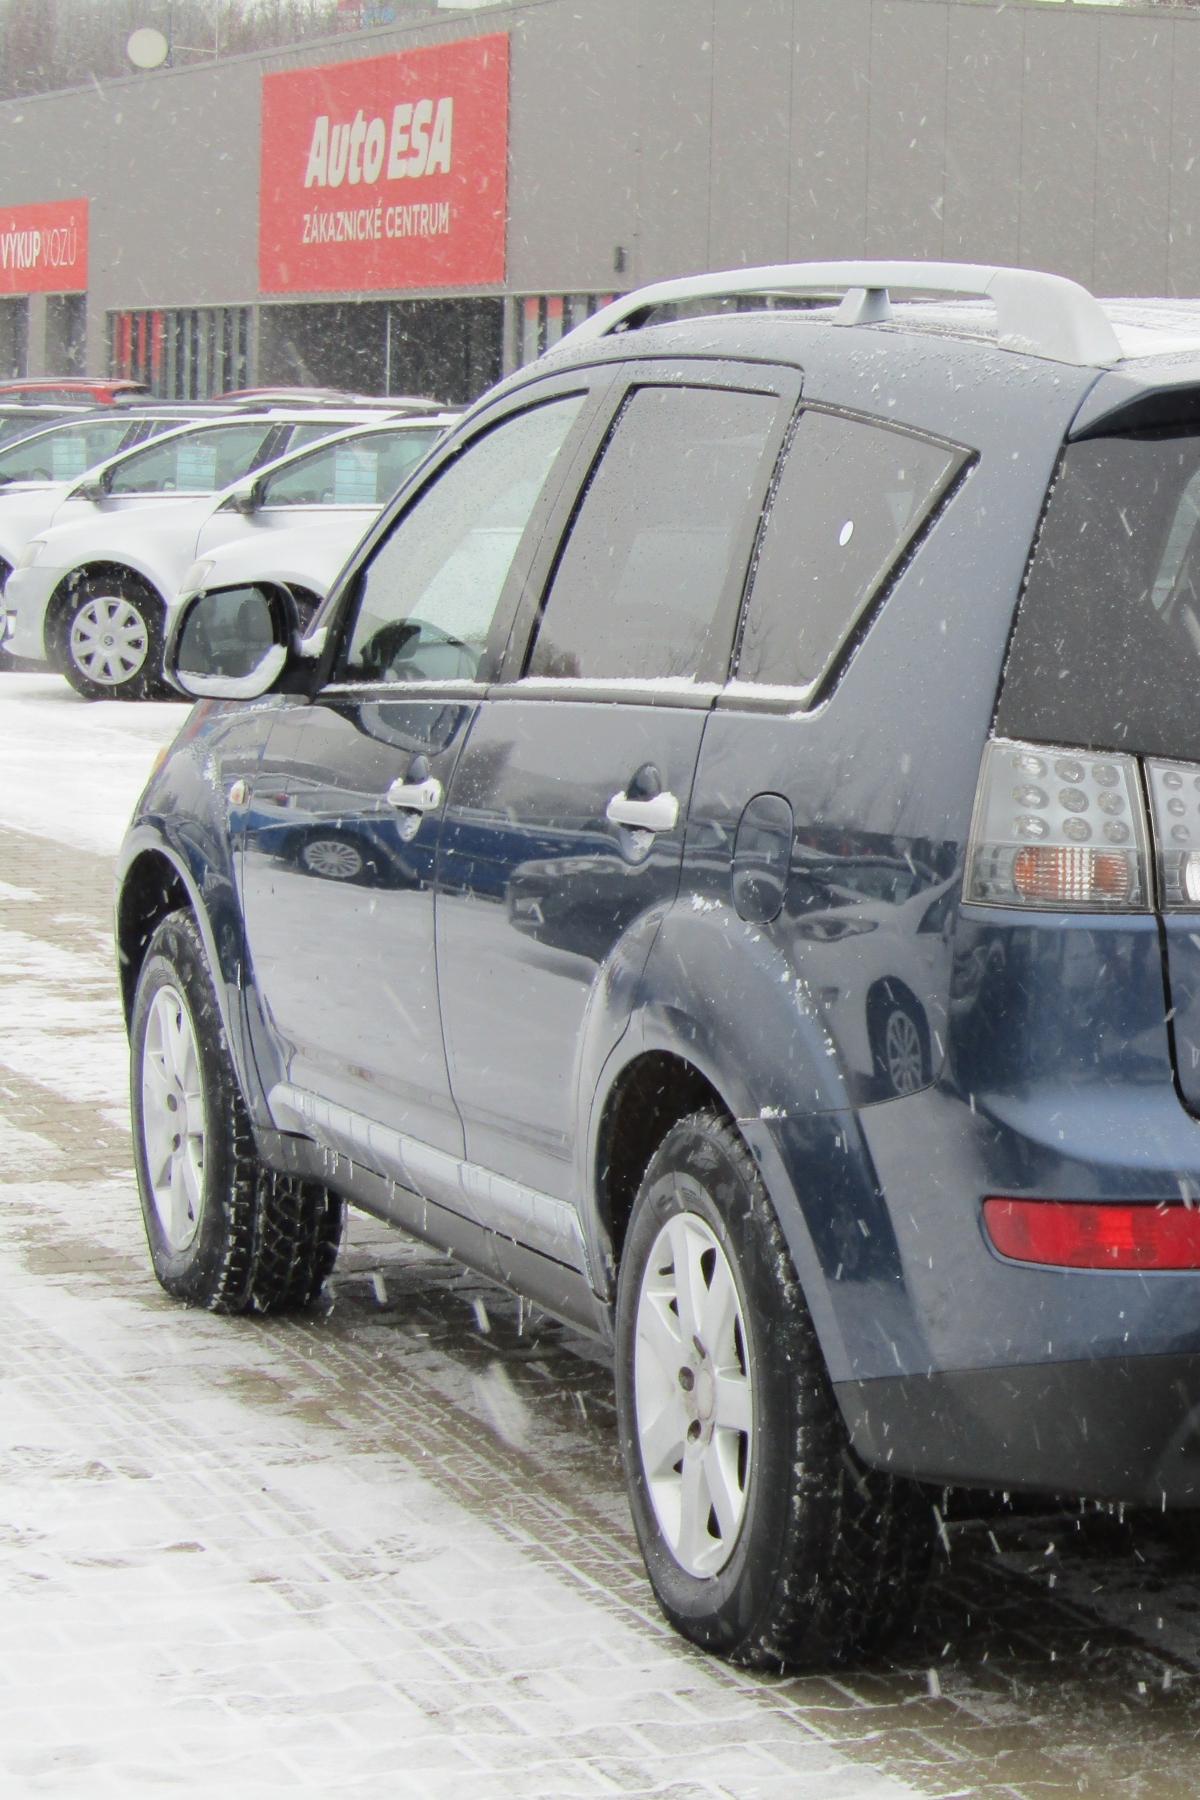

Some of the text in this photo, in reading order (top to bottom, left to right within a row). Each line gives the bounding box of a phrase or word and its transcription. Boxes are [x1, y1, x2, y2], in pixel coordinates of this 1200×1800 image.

[303, 96, 453, 188] Auto ESA
[302, 197, 449, 243] ZÁKAZNICKÉ CENTRUM
[1, 221, 40, 269] VÝKUP
